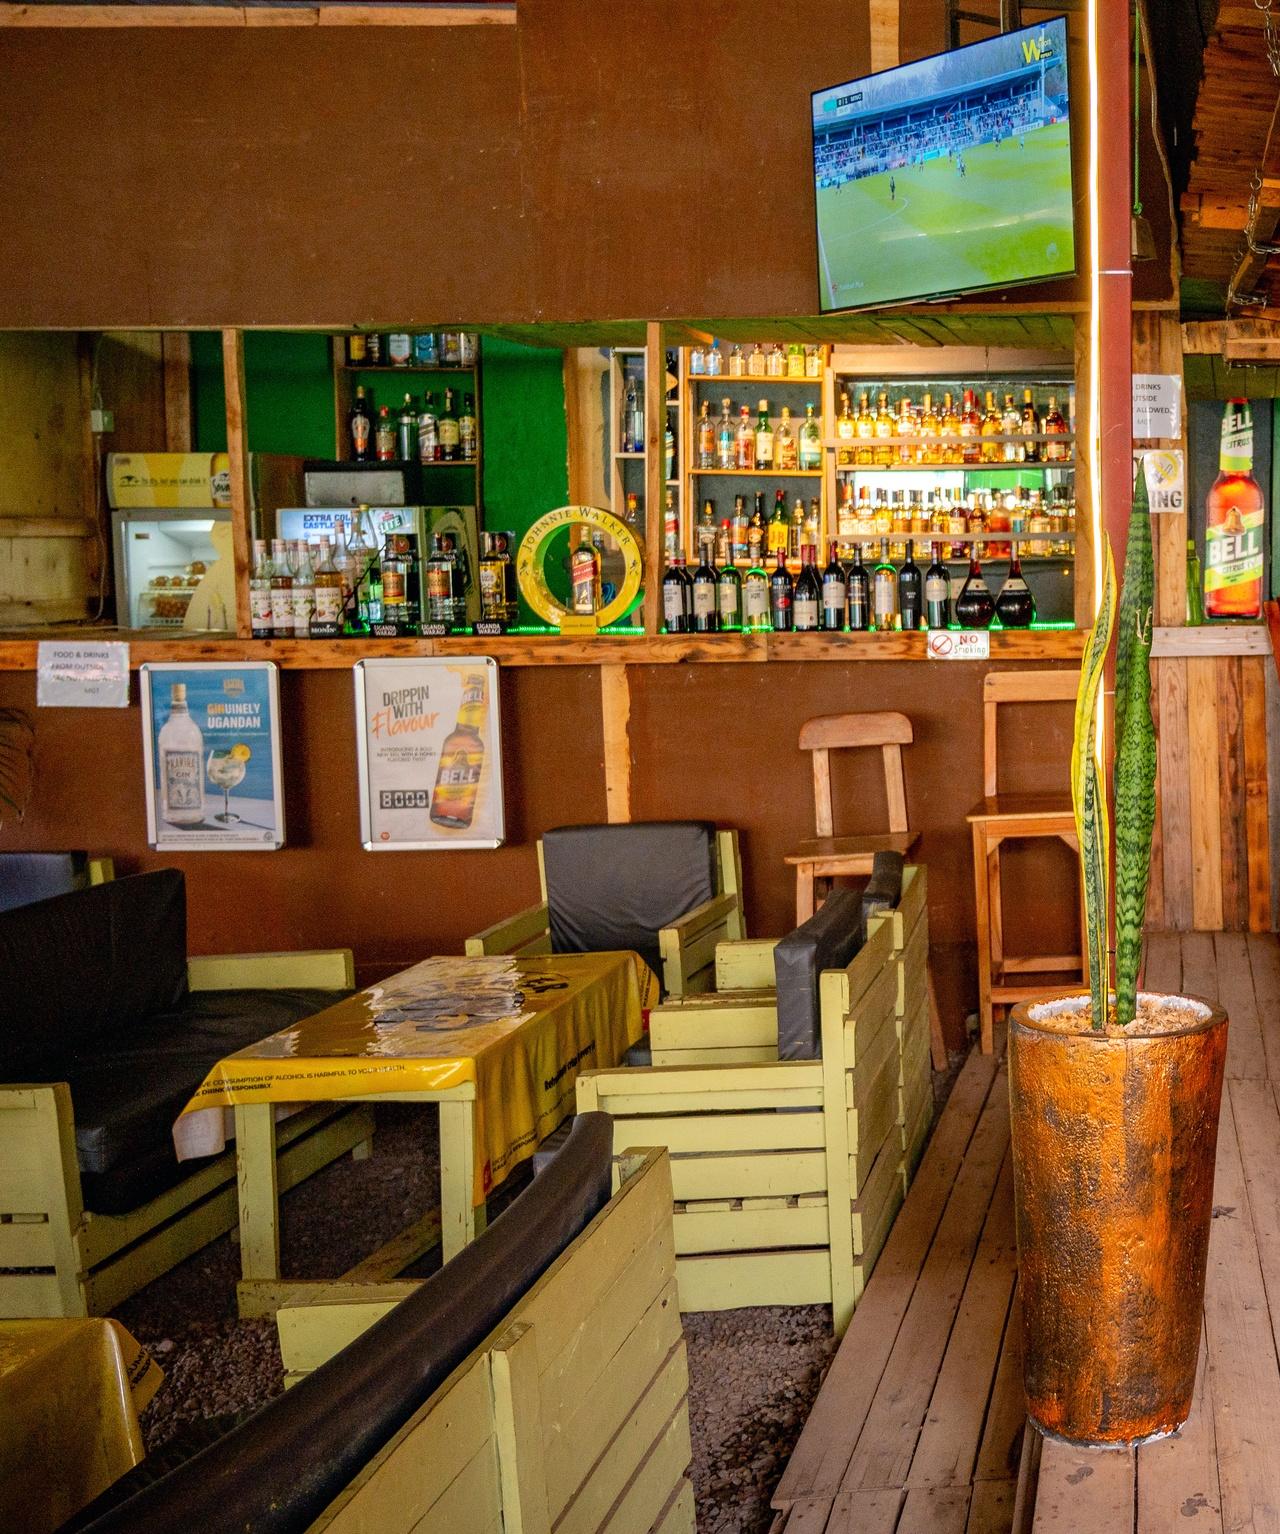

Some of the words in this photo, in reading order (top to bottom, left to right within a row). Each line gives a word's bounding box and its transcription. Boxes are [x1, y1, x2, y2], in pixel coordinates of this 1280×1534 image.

[1135, 383, 1161, 391] DRINKS
[1221, 410, 1254, 435] BELL
[304, 514, 332, 522] EXTRA
[521, 509, 573, 553] JOHNNIE
[579, 506, 632, 545] WALKER
[1209, 530, 1259, 565] BELL
[311, 624, 336, 633] MONIN
[960, 634, 978, 645] NO
[53, 650, 74, 659] FOOD
[83, 650, 110, 659] DRINKS
[382, 684, 430, 707] DRIPPIN
[393, 701, 423, 719] WITH
[207, 716, 261, 729] UGANDAN
[371, 706, 440, 739] Flavour
[440, 767, 475, 785] BELL
[275, 1072, 305, 1081] ALCOHOL
[314, 1070, 346, 1079] HARMFUL
[201, 1086, 225, 1096] DRINK
